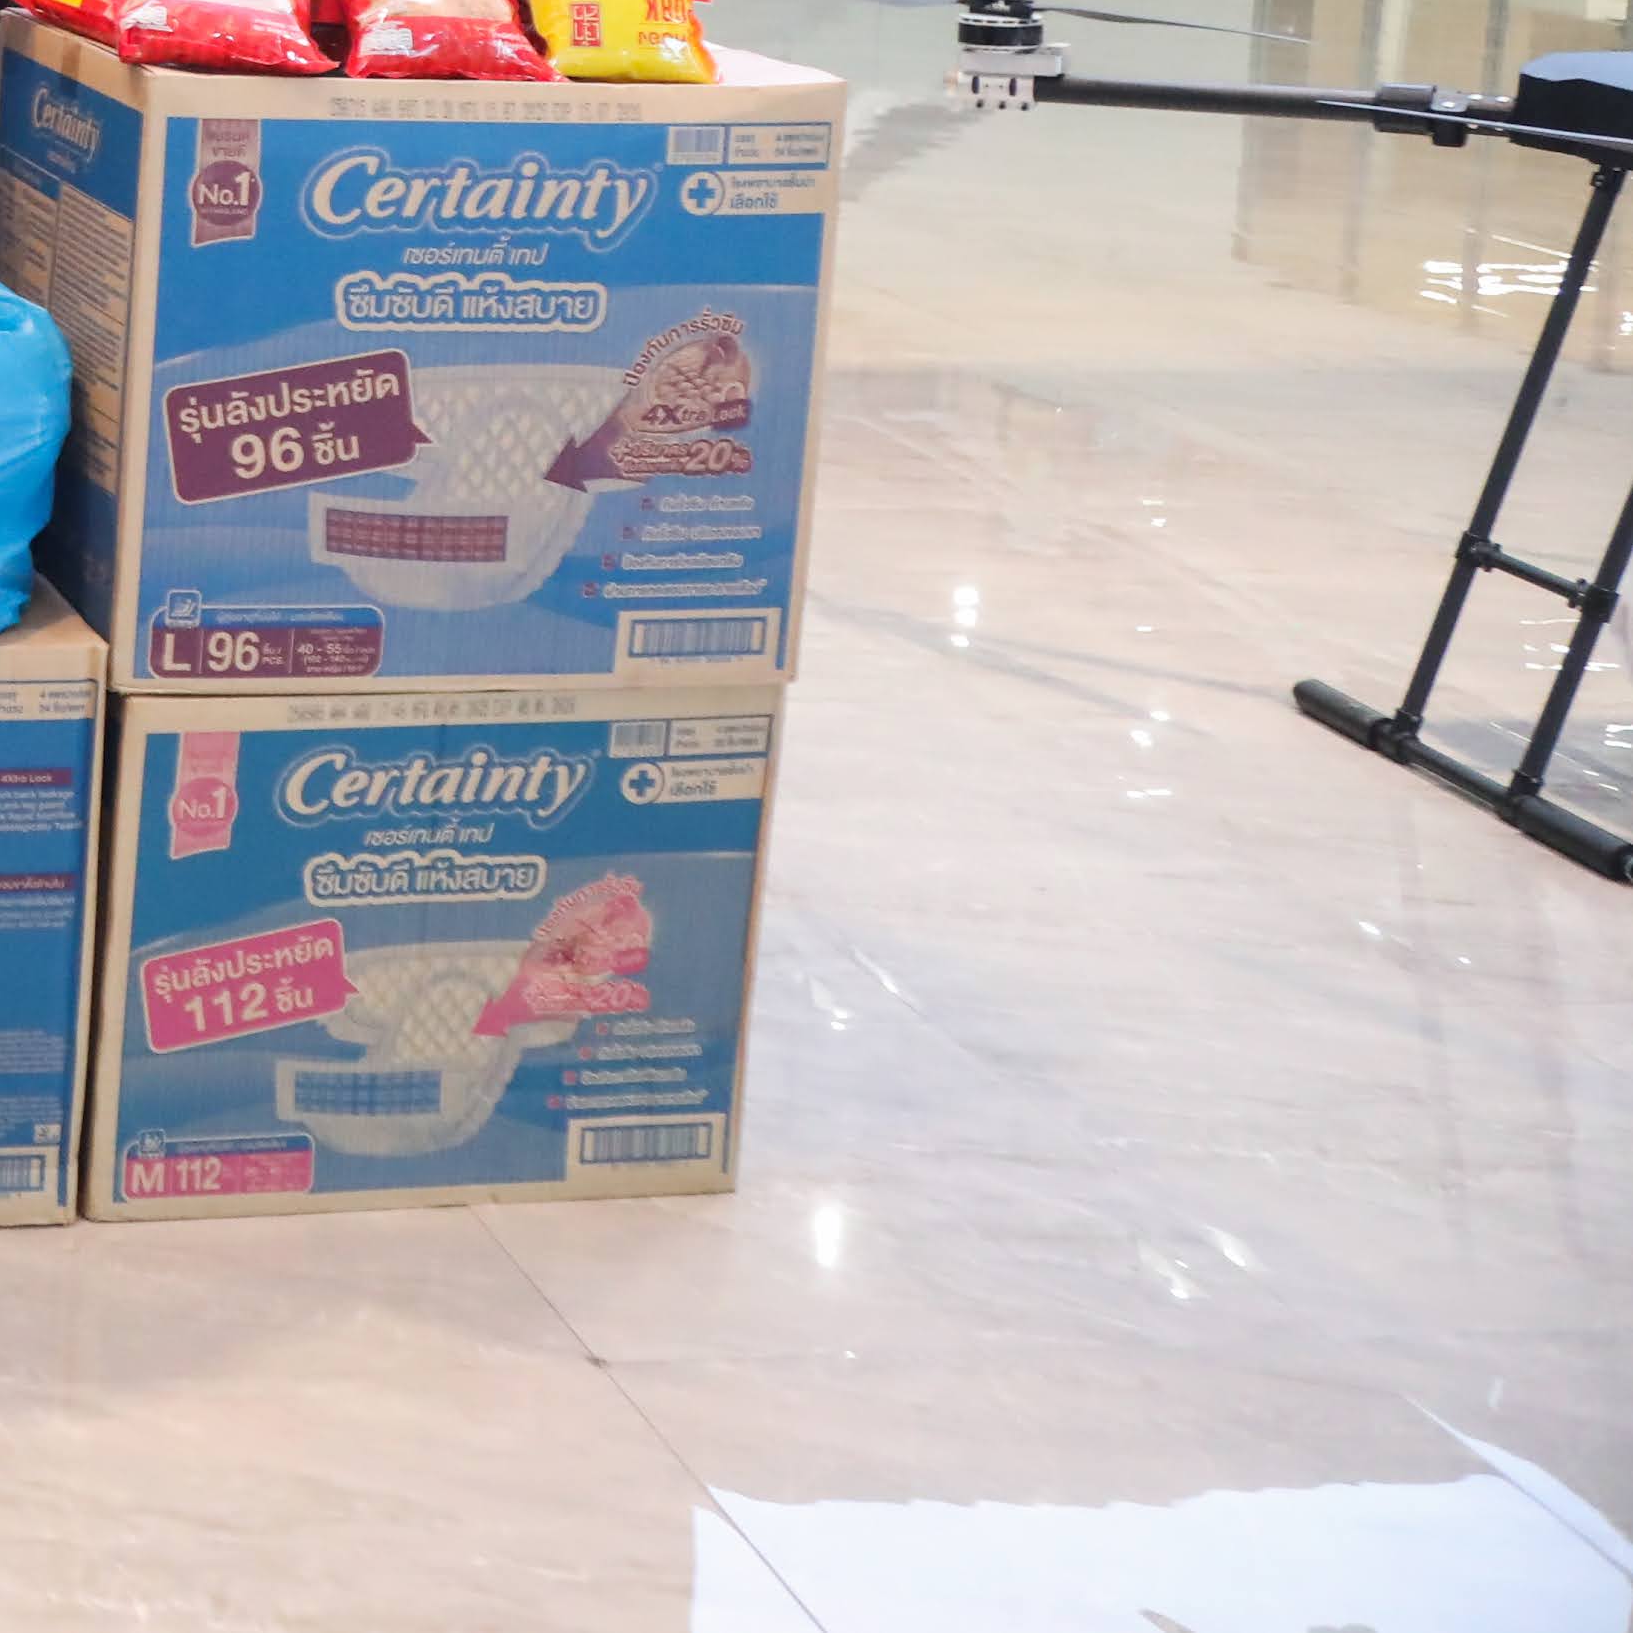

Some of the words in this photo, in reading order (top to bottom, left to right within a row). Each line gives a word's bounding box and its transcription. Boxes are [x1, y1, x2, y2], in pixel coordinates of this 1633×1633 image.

[312, 155, 648, 239] Certainty
[511, 241, 548, 266] เทป
[349, 286, 455, 321] ซึมซับดี
[463, 286, 595, 321] แห้งสบาย
[180, 368, 400, 444] รุ่นลังประหยัด
[231, 426, 305, 479] 96
[312, 421, 360, 466] ชิ้น
[162, 633, 191, 671] L
[208, 631, 261, 673] 96
[286, 751, 586, 818] Certainty
[315, 864, 409, 895] ซึมซับดี
[415, 861, 536, 893] แห้งสบาย
[153, 935, 334, 1004] รุ่นลังประหยัด
[185, 982, 269, 1032] 112
[275, 977, 314, 1013] ชิ้น
[132, 1163, 165, 1193] M
[176, 1156, 222, 1191] 112
